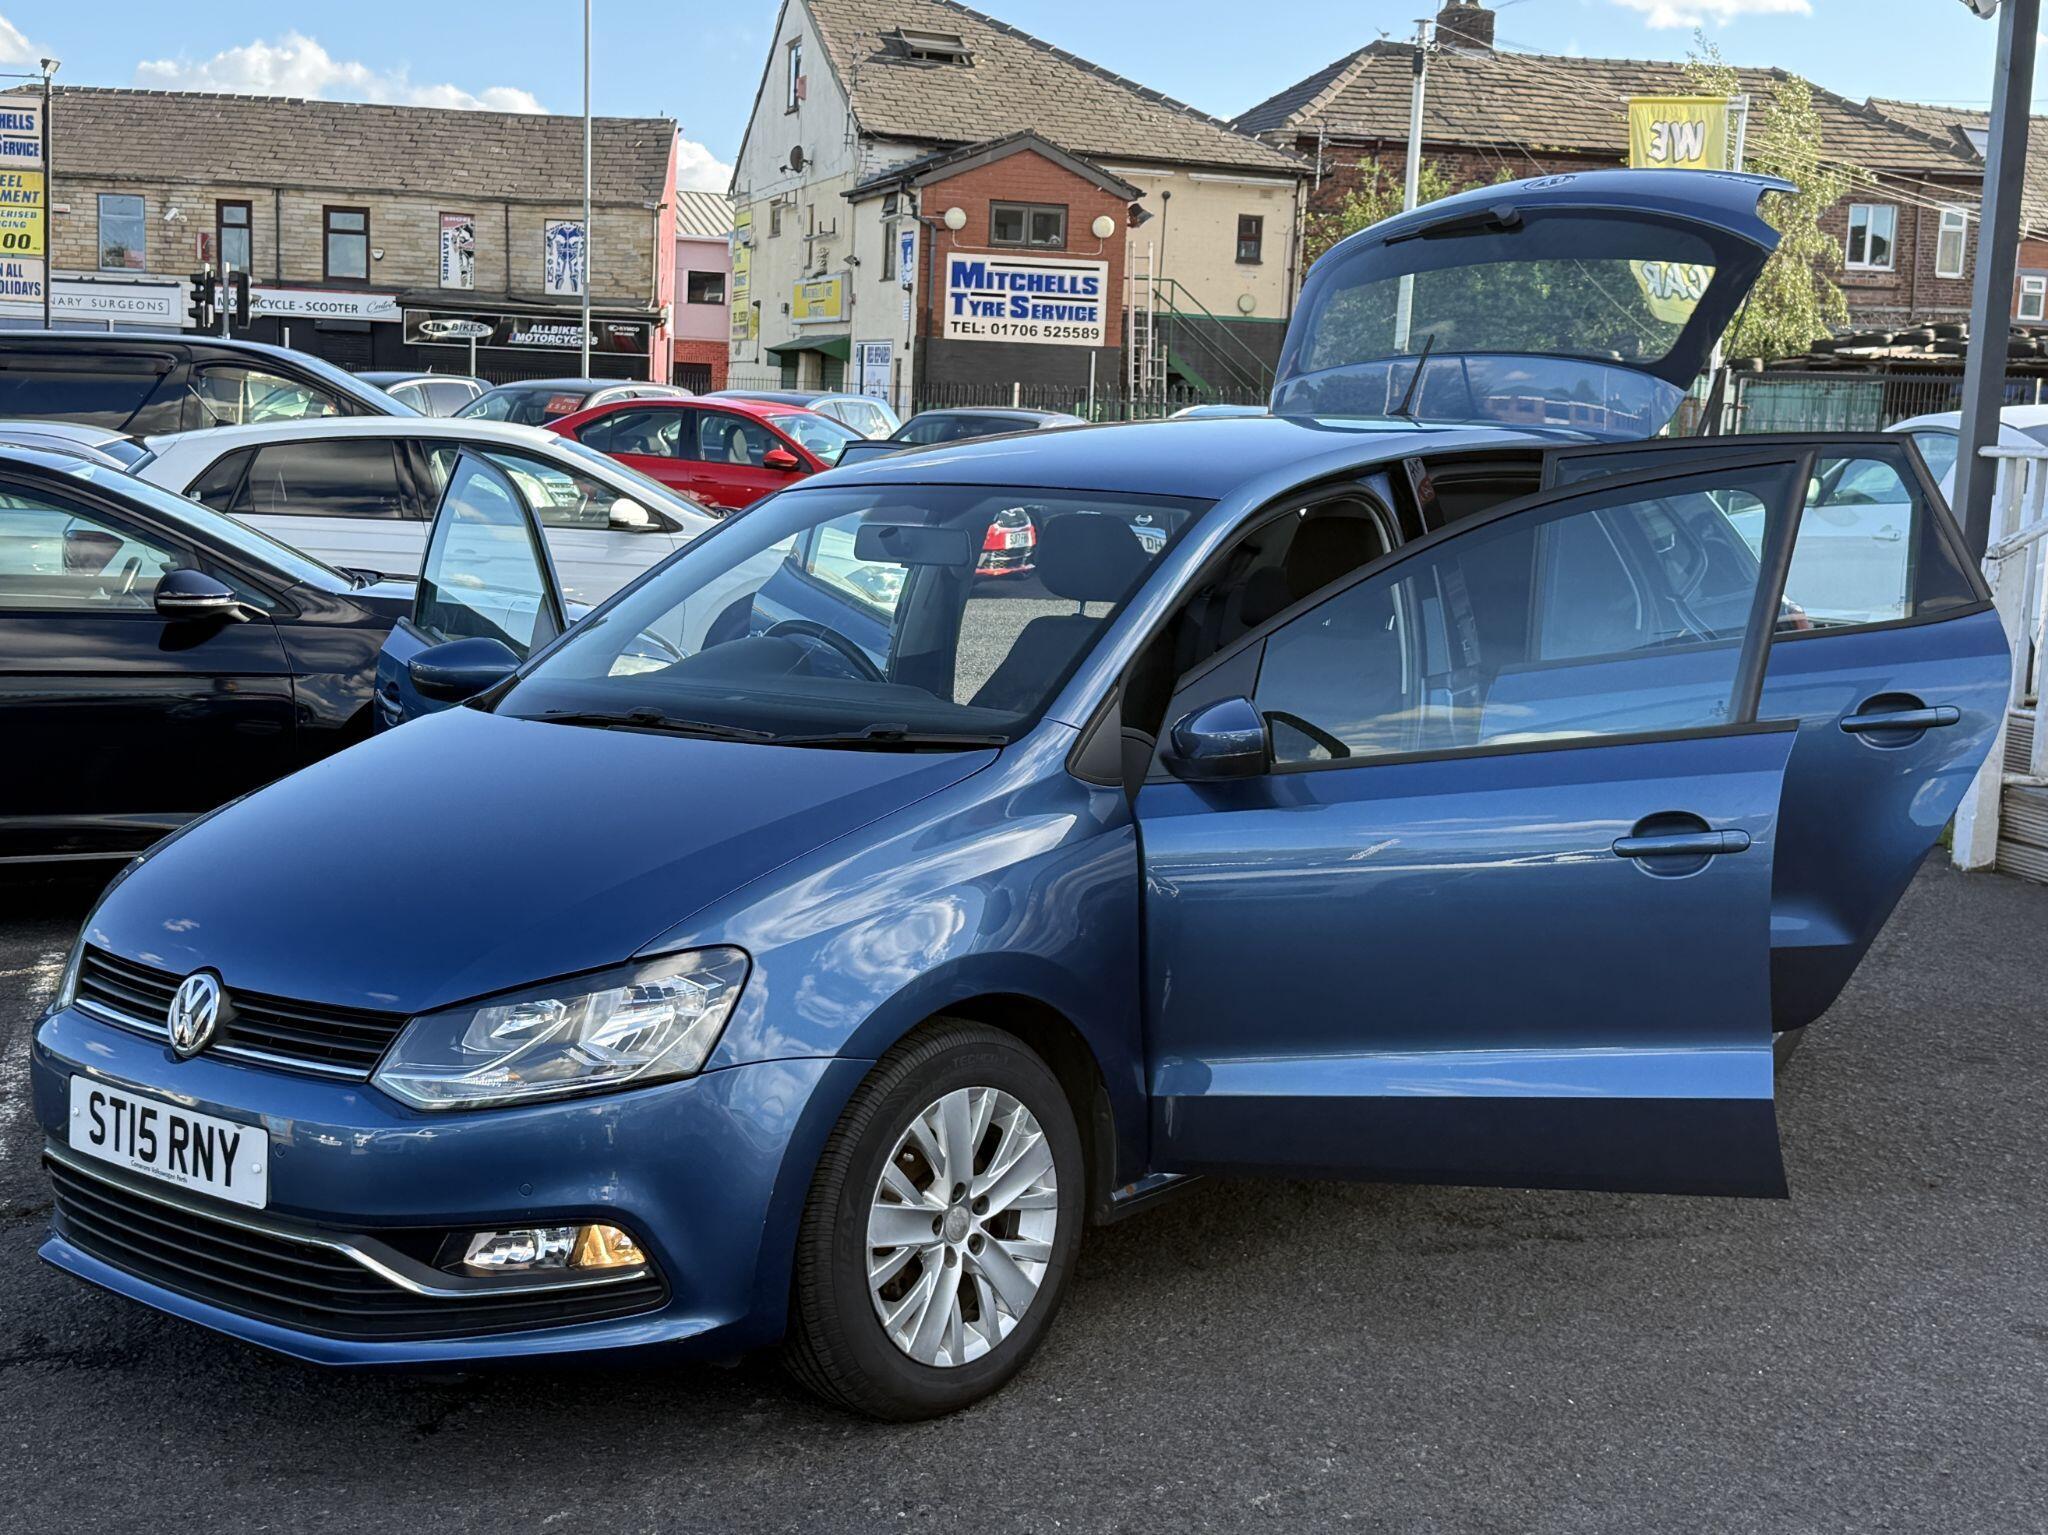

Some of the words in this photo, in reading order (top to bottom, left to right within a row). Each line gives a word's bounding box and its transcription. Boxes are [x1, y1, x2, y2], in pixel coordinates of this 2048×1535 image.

[0, 135, 39, 157] ERVICE
[6, 263, 23, 278] ALL
[951, 260, 1099, 295] MITCHELLS
[91, 298, 164, 311] SURGEONS
[217, 296, 295, 310] MORCYCLE
[305, 301, 358, 314] SCOOTER
[951, 292, 1005, 317] TYRE
[1009, 295, 1098, 322] SERVICE
[451, 322, 484, 333] BIKES
[950, 321, 985, 334] TEL:
[990, 322, 1038, 337] 01706
[1043, 325, 1099, 340] 525589
[516, 332, 598, 345] MOTORCYCLS
[89, 1090, 158, 1163] ST15
[168, 1114, 241, 1188] RNY
